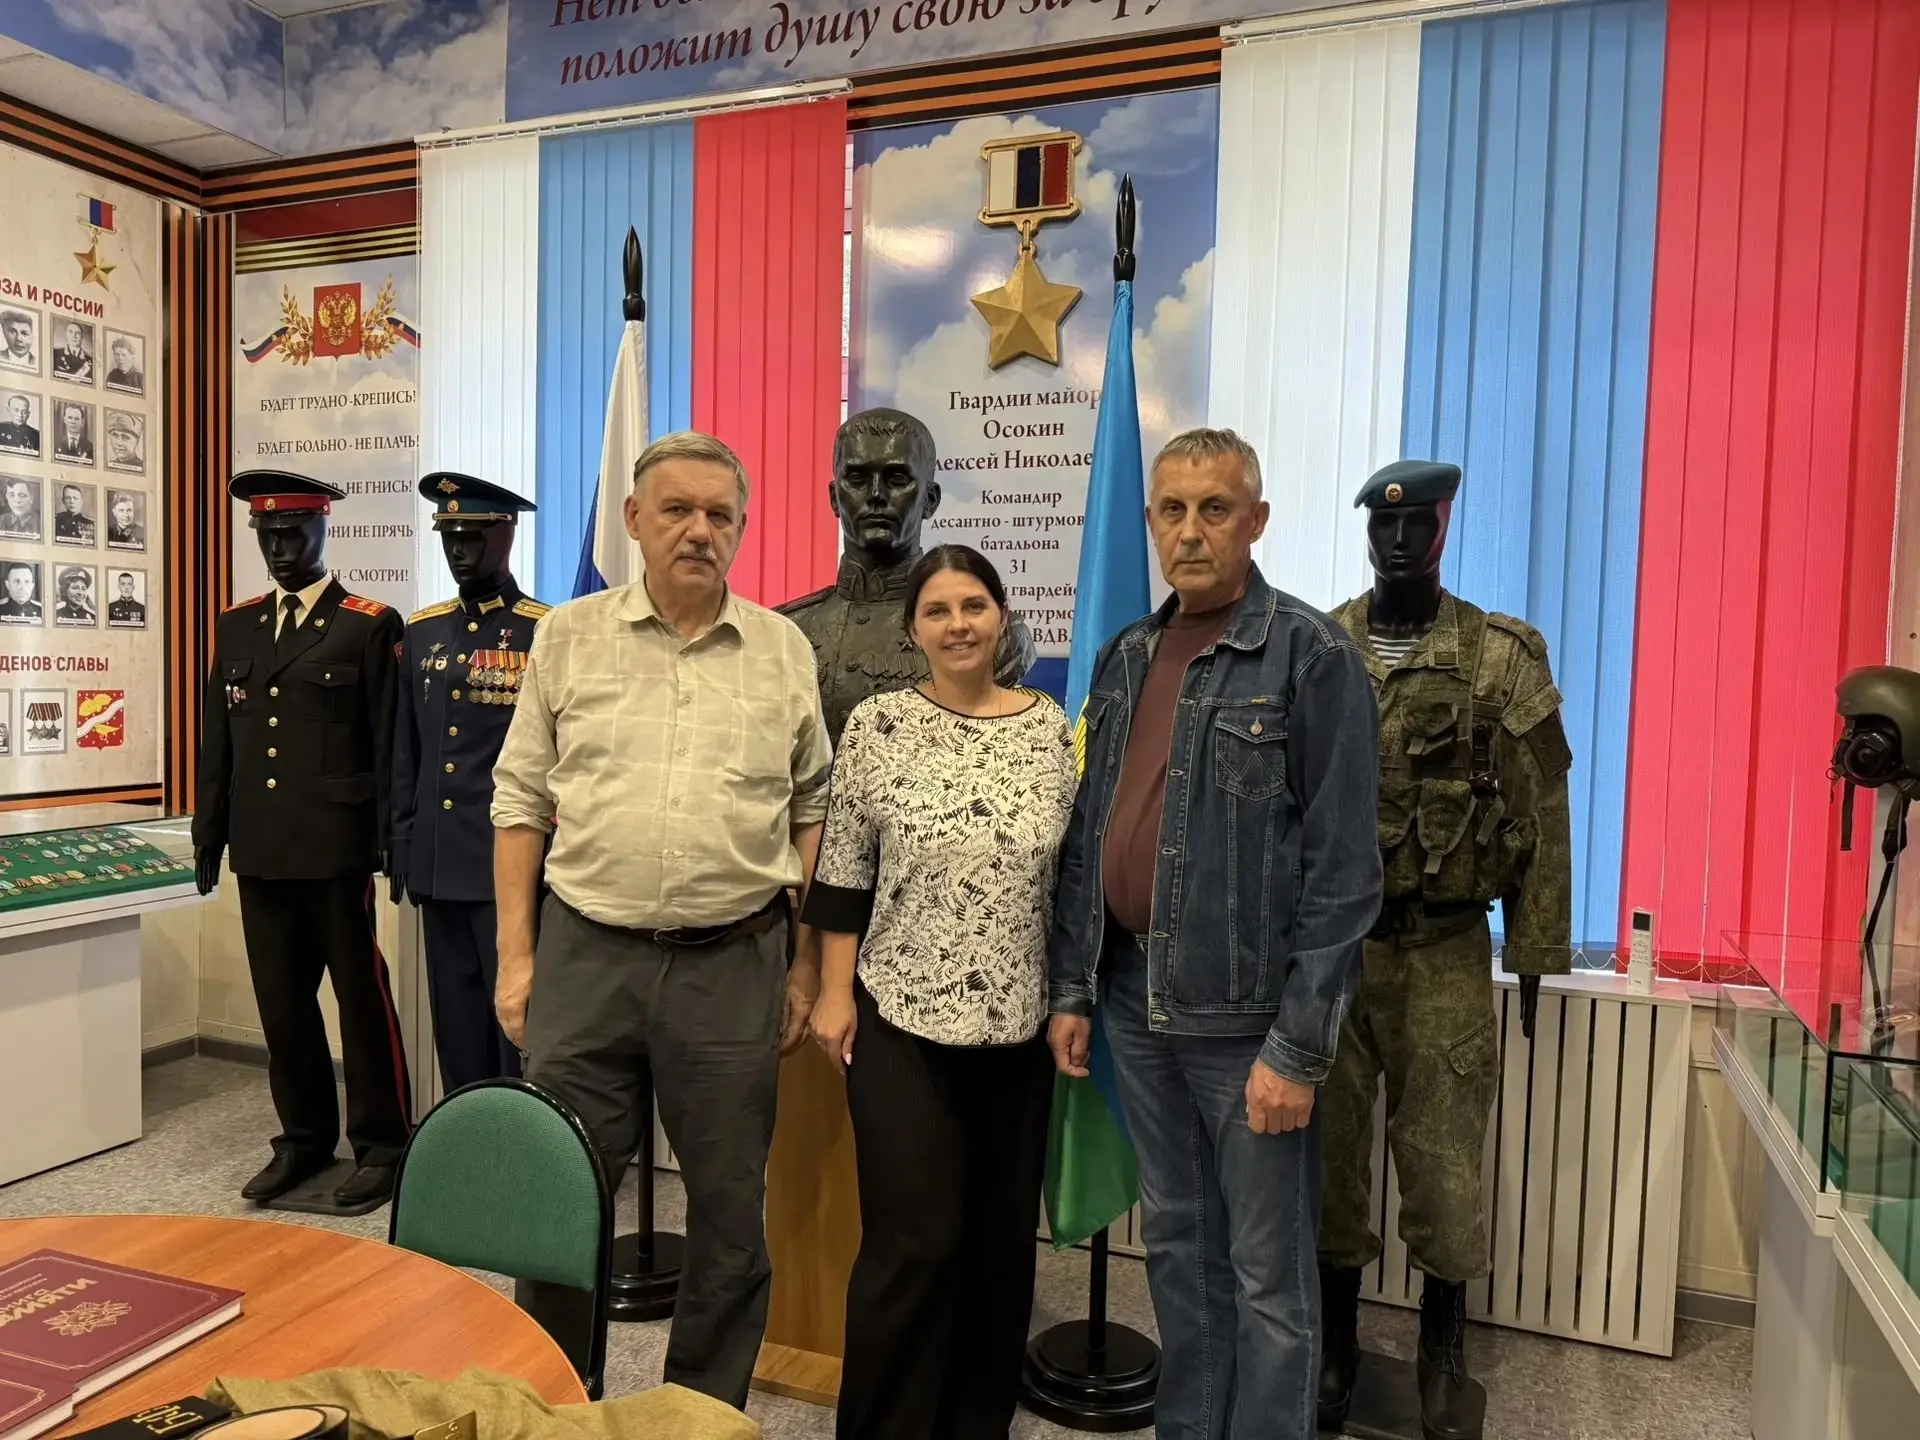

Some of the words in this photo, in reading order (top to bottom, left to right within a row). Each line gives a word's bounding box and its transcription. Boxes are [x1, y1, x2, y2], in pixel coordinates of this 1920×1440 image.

[560, 27, 752, 85] положит
[764, 3, 880, 68] душу
[892, 0, 1003, 33] свою
[0, 278, 22, 298] ЗА
[28, 284, 38, 302] И
[43, 289, 104, 319] РОССИИ
[260, 398, 296, 414] БУДЕТ
[300, 394, 348, 411] ТРУДНО
[949, 391, 1032, 415] Гвардии
[1036, 387, 1101, 409] майор
[983, 420, 1065, 439] Осокин
[257, 440, 293, 456] БУДЕТ
[295, 438, 347, 453] БОЛЬНО
[355, 437, 372, 451] НЕ
[374, 435, 420, 450] ПЛАЧЬ!
[1004, 450, 1093, 469] Николае
[346, 482, 365, 495] НЕ
[365, 480, 413, 494] ГНИСЬ!
[981, 490, 1062, 507] Командир
[353, 525, 370, 538] НЕ
[371, 524, 413, 537] ПРЯЧЬ
[931, 516, 1000, 530] десантно
[1012, 515, 1085, 531] штурмов
[980, 535, 1060, 551] батальона
[349, 568, 409, 582] СМОТРИ!
[1009, 559, 1027, 574] 31
[1032, 627, 1073, 645] ВДВ.
[0, 656, 52, 673] ДЕНОВ
[56, 657, 109, 672] СЛАВЫ
[953, 720, 987, 743] Happy
[1022, 713, 1046, 731] NEW
[972, 741, 995, 769] NEW
[994, 749, 1022, 762] Artist
[994, 776, 1027, 799] NEW
[939, 803, 970, 825] Happy
[957, 877, 991, 906] Happy
[973, 904, 998, 937] NEW
[994, 945, 1021, 970] NEW
[933, 974, 964, 1000] Happy
